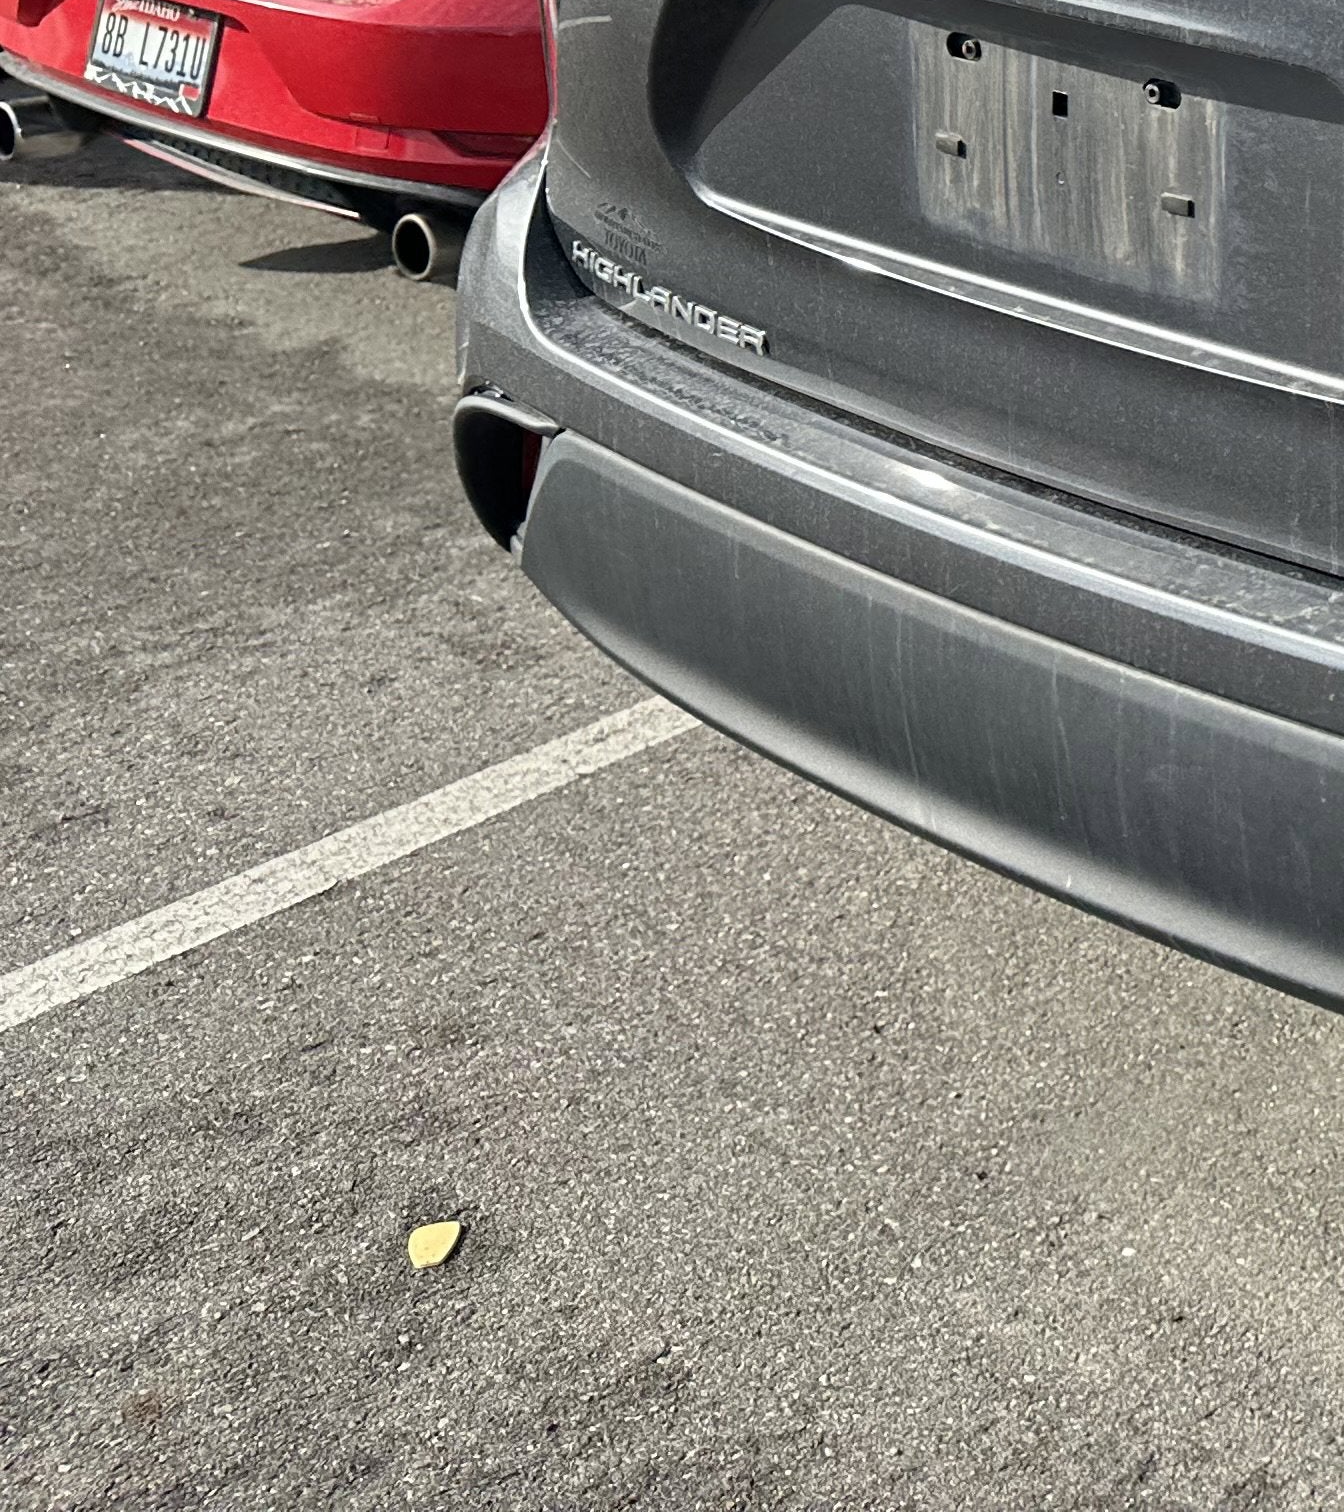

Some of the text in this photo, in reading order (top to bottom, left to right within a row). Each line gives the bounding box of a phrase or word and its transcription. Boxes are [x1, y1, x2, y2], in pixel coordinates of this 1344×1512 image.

[101, 12, 206, 81] 8B L731U
[605, 228, 648, 266] TOYOTA
[572, 240, 769, 357] HIGHLANDER
